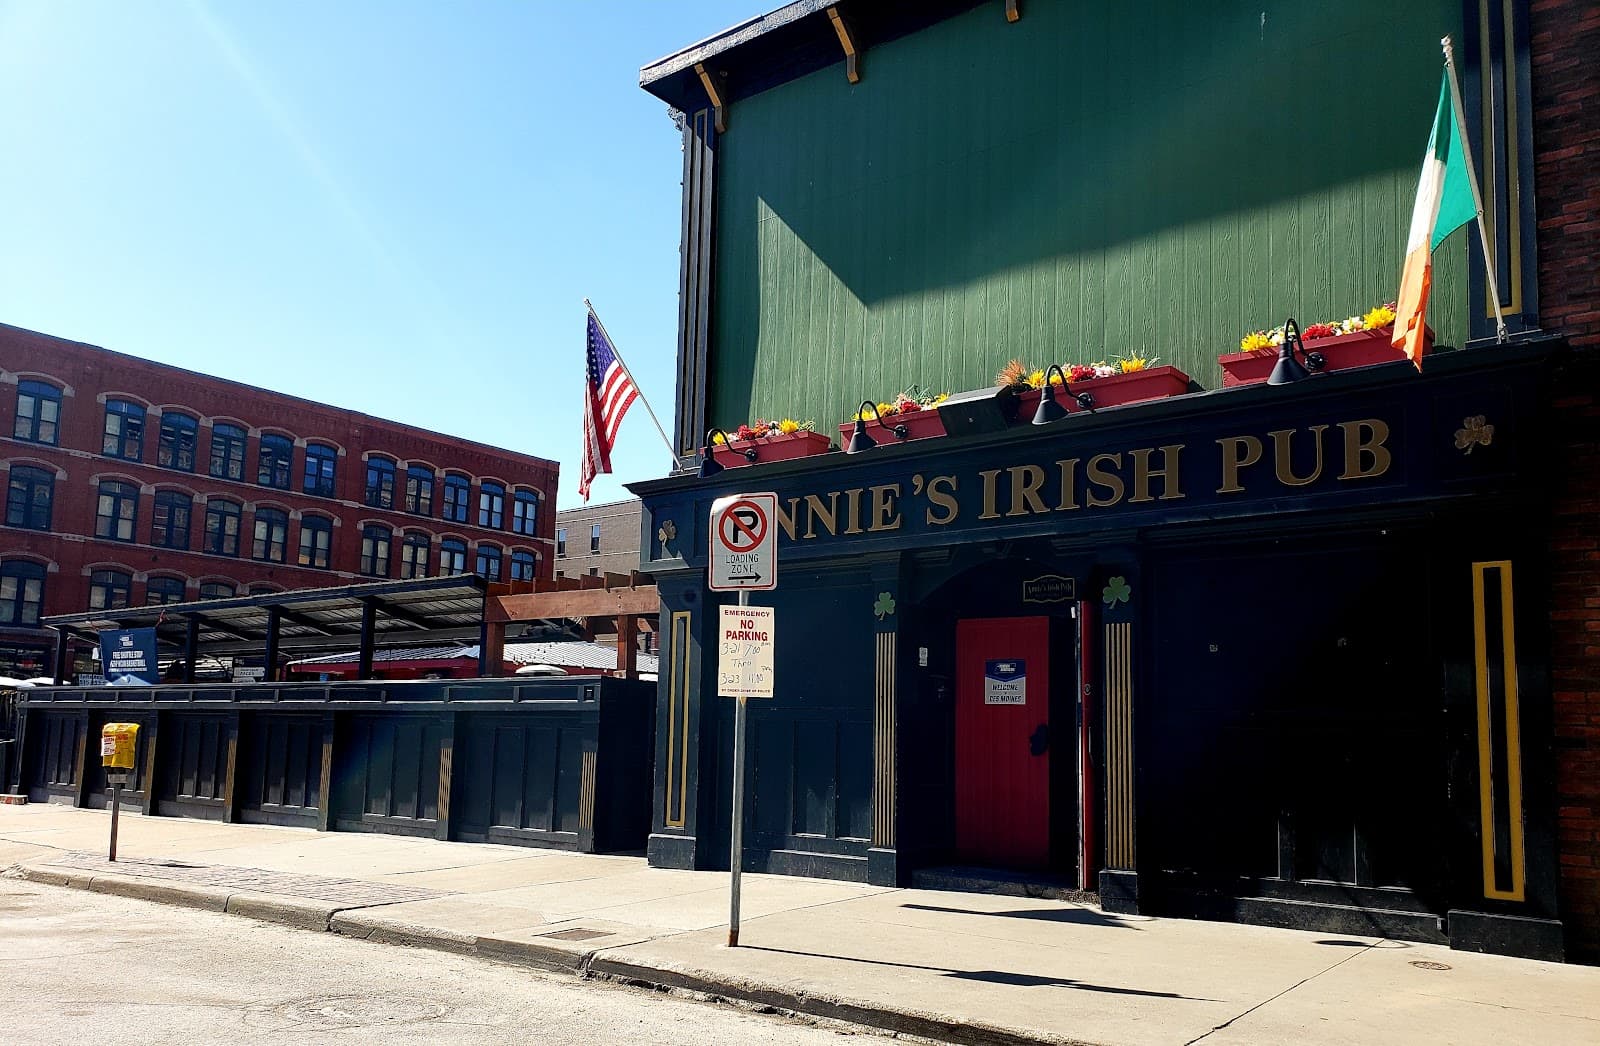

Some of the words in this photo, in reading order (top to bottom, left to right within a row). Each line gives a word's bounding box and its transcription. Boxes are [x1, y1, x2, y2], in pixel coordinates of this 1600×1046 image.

[777, 474, 959, 542] NNIE'S
[978, 444, 1186, 520] IRISH
[1215, 418, 1392, 494] PUB
[725, 553, 759, 564] LOADING
[731, 564, 754, 574] ZONE
[724, 609, 770, 618] EMERGENCY
[740, 619, 754, 630] NO
[726, 630, 768, 641] PARKING
[992, 683, 1019, 691] WELCOME
